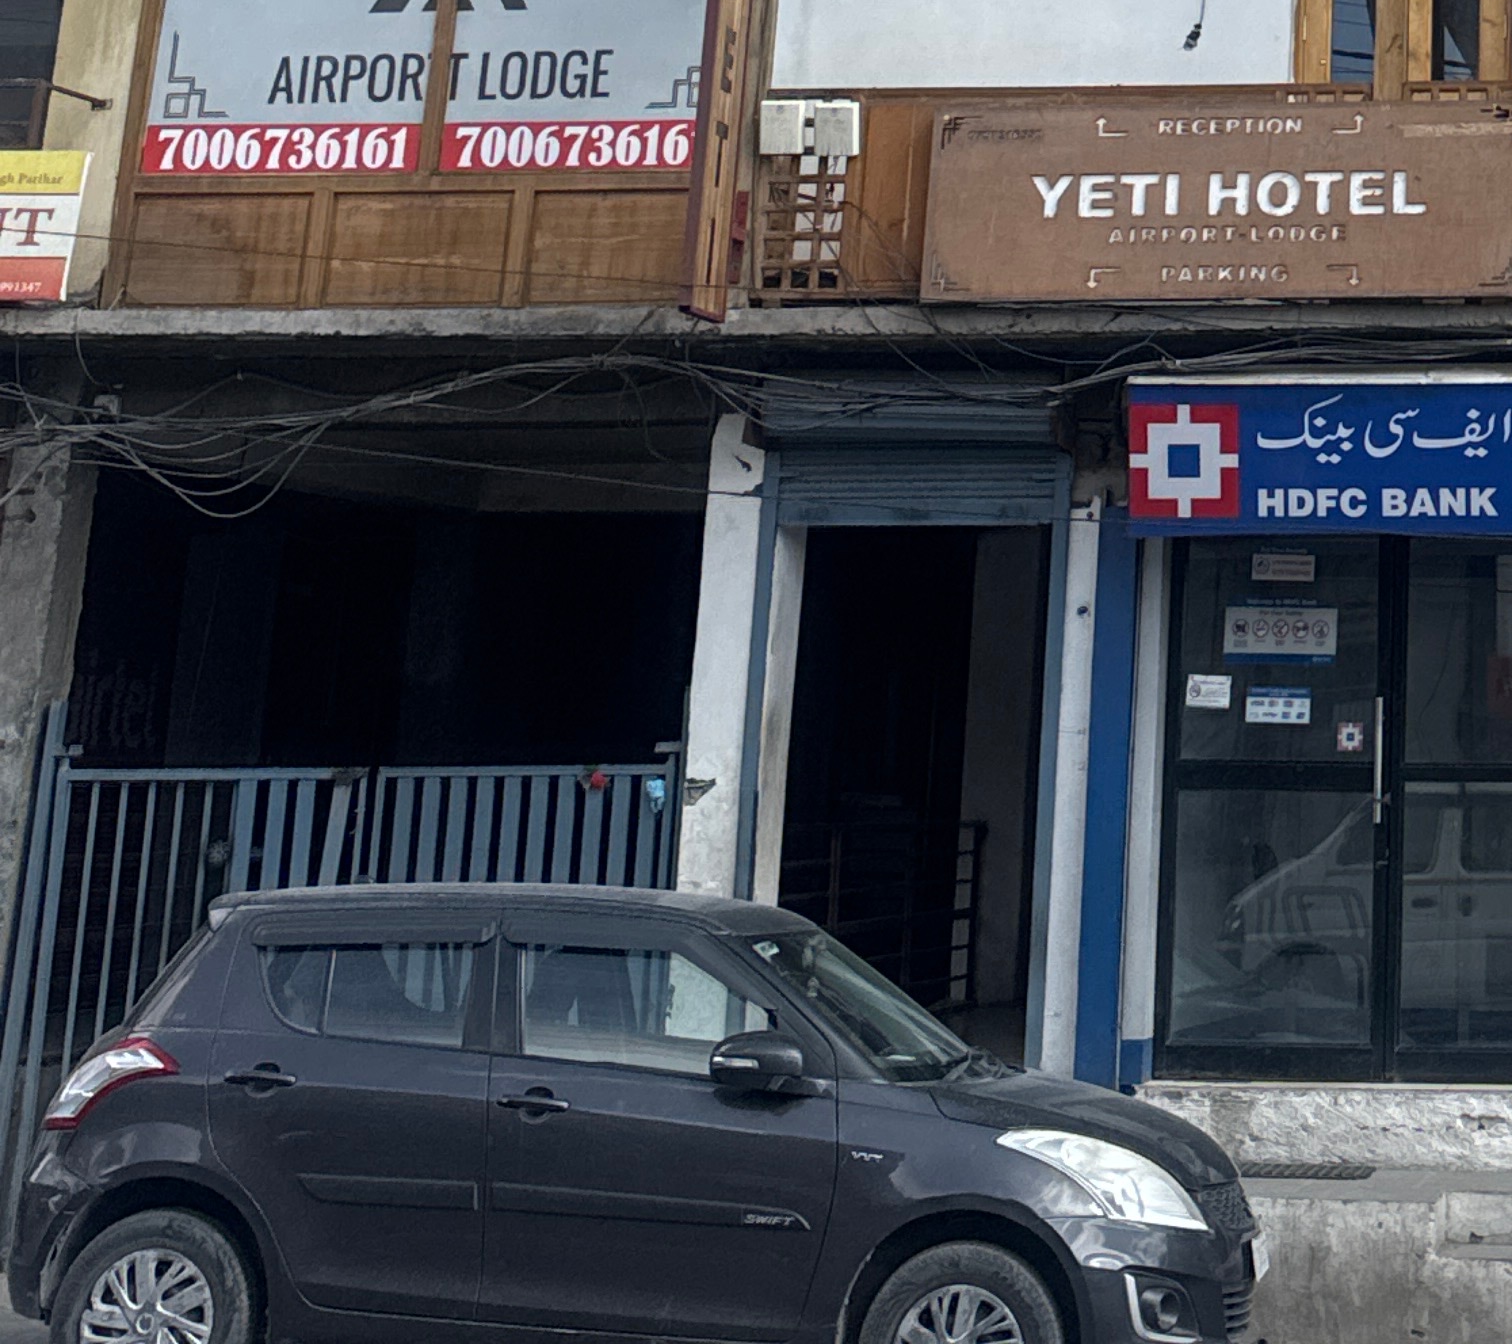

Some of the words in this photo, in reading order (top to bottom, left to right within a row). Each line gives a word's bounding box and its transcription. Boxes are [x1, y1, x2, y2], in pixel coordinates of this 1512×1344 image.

[477, 49, 614, 101] LODGE
[157, 125, 408, 171] 7006736161
[454, 122, 696, 169] 700673616
[1157, 117, 1303, 136] RECEPTION
[1030, 172, 1180, 218] YETI
[1206, 170, 1427, 217] HOTEL
[1161, 264, 1289, 283] PARKING
[1256, 393, 1356, 465] بینک
[1257, 487, 1368, 518] HDFC
[1381, 487, 1500, 518] BANK
[743, 1213, 797, 1227] SWIFT
